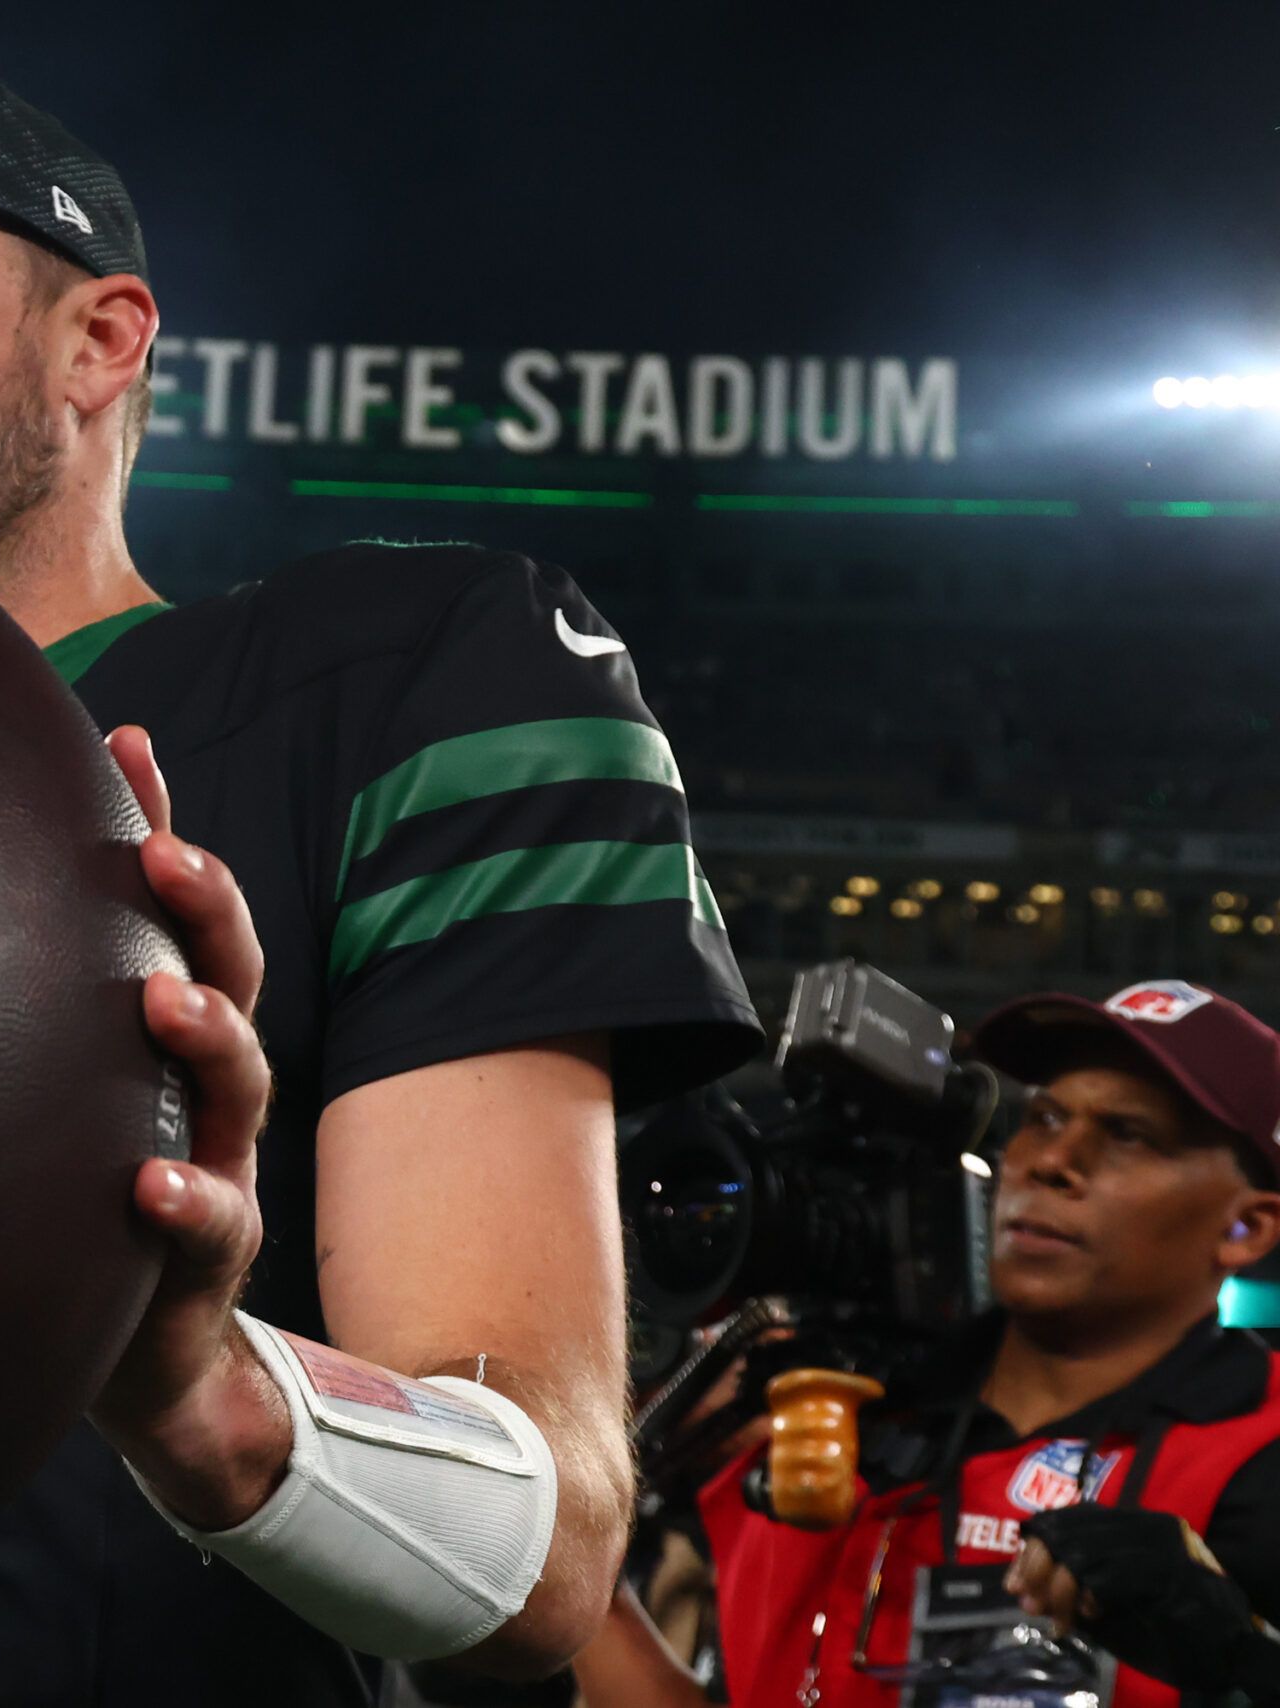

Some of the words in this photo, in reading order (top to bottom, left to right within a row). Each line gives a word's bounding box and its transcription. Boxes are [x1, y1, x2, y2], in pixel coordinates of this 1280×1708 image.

[144, 337, 463, 449] ETLIFE
[496, 348, 958, 461] STADIUM
[956, 1514, 1026, 1553] TELE
